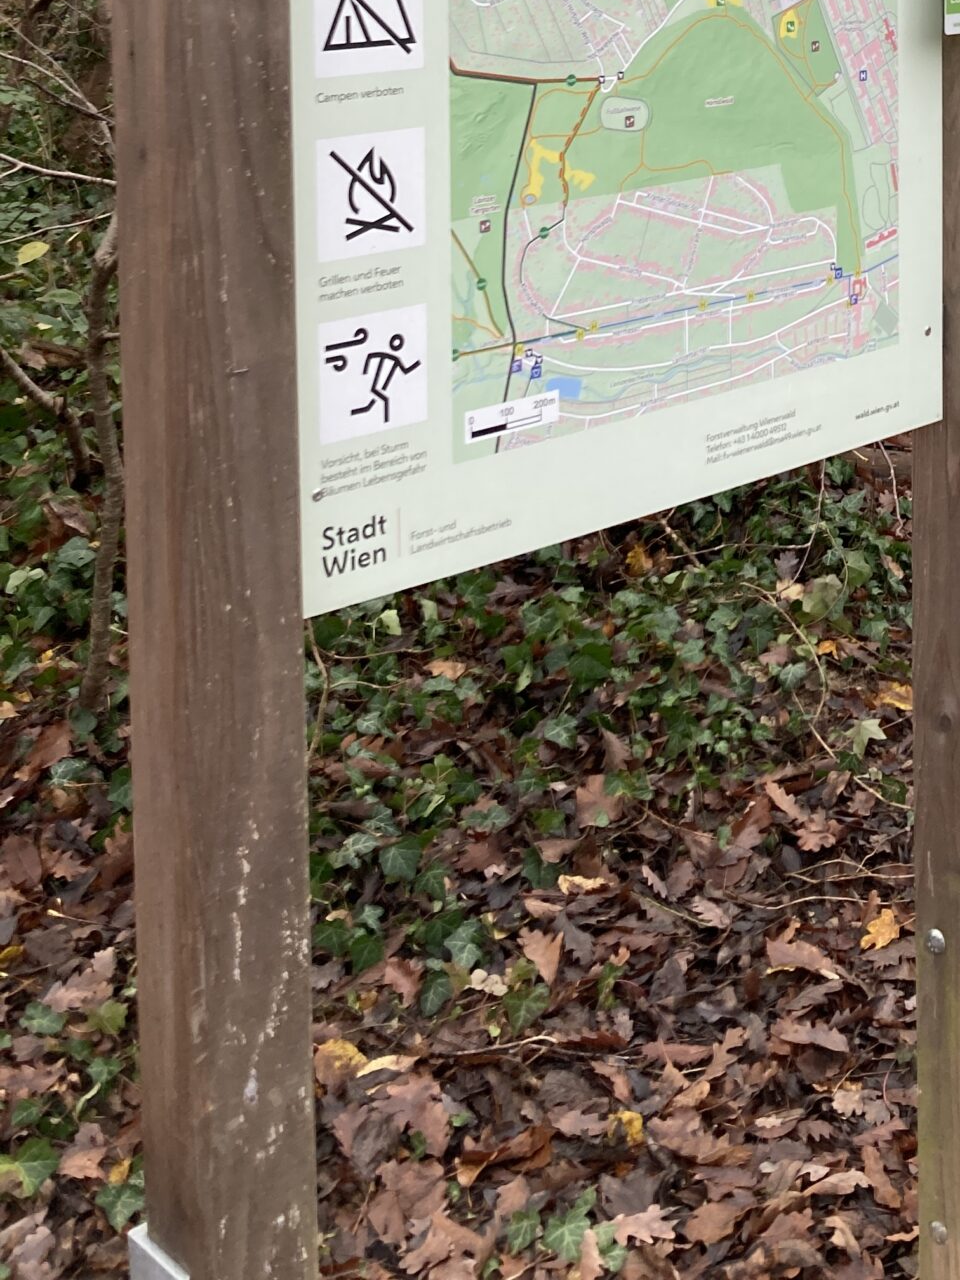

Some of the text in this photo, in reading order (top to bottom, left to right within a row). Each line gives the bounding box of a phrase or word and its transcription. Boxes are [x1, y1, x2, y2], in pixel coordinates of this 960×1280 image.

[315, 87, 404, 103] Campen verboten
[352, 268, 373, 281] und
[360, 279, 404, 293] verboten
[500, 406, 515, 417] 100
[322, 515, 388, 551] Stadt
[322, 547, 387, 578] Wien
